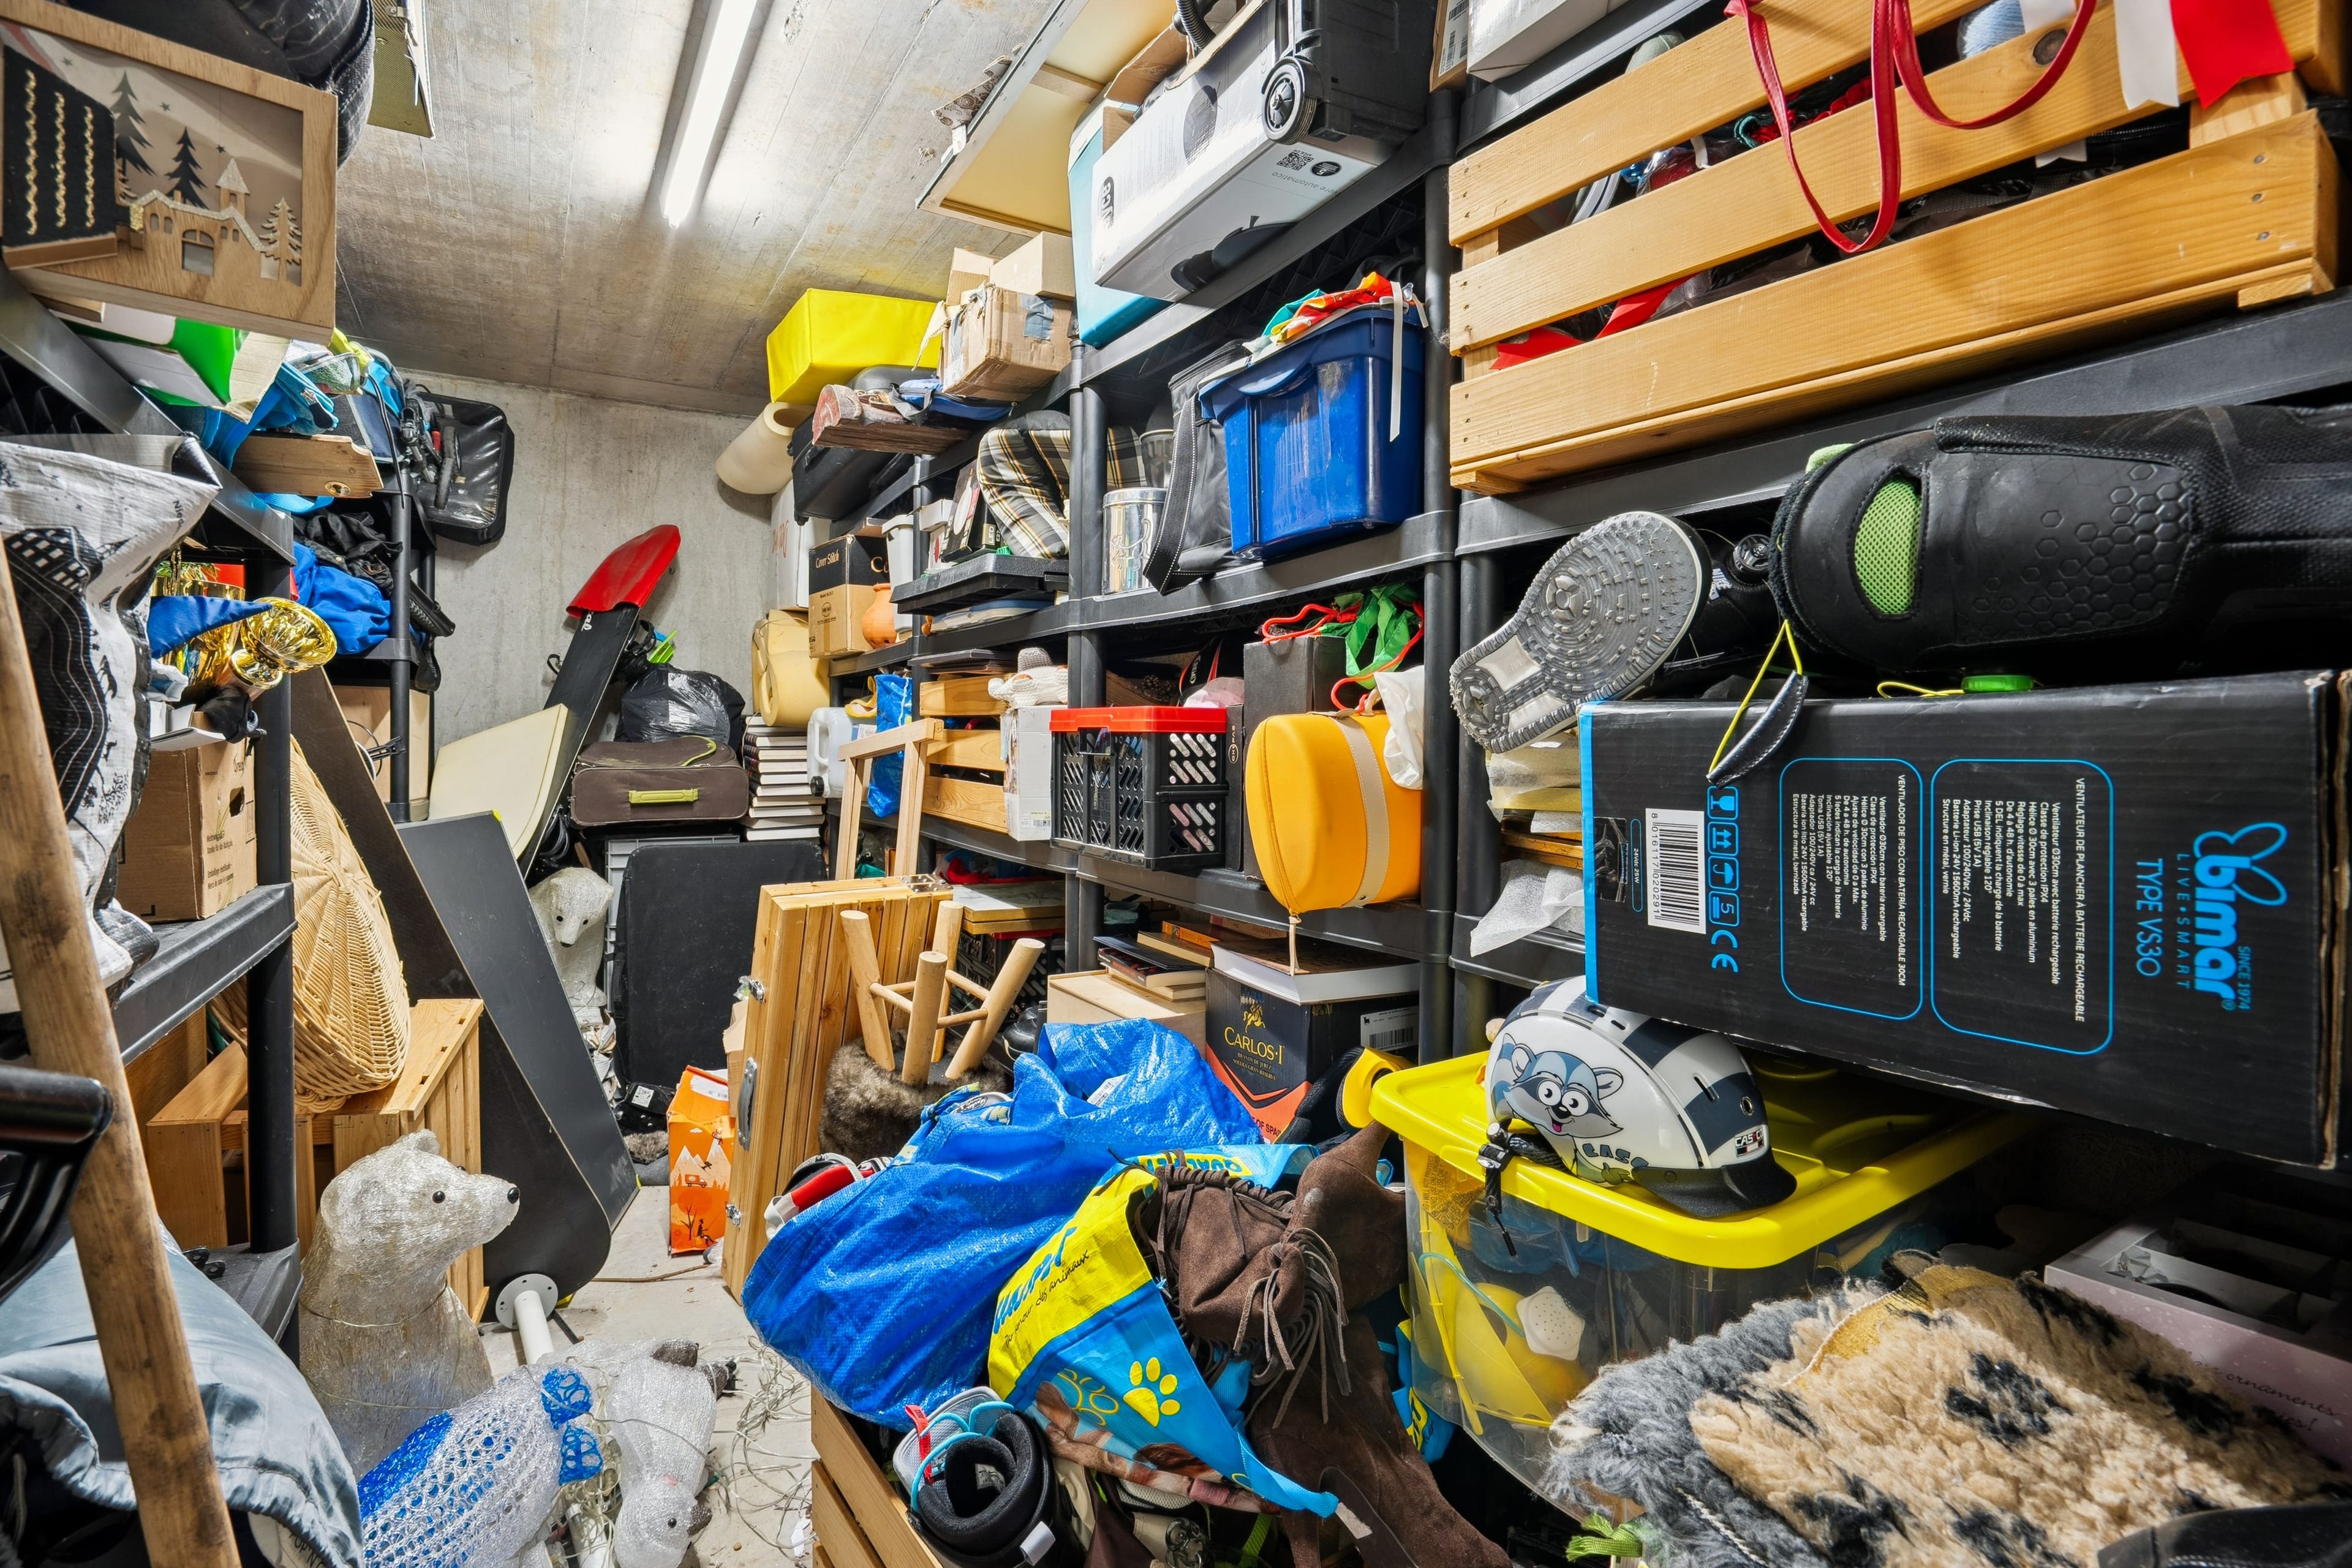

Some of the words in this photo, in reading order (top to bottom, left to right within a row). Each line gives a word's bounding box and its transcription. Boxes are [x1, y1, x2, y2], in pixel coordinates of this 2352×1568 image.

[1271, 171, 1319, 190] automatico
[815, 556, 827, 569] Cover
[827, 549, 840, 565] Stitch
[1850, 795, 1860, 818] Ajuste
[1860, 796, 1869, 818] Hélice
[1869, 796, 1878, 816] Clase
[1898, 774, 1906, 824] VENTILADOR
[2075, 778, 2086, 838] VENTILATEUR
[1852, 818, 1860, 829] de
[1869, 816, 1878, 826] de
[1879, 796, 1887, 834] Ventilador
[1942, 799, 1951, 834] Structure
[1952, 799, 1961, 829] Batterie
[1984, 800, 1993, 841] Inclinaison
[1994, 807, 2004, 824] DEL
[2015, 801, 2027, 834] Réglage
[2028, 801, 2038, 826] Hélice
[2040, 802, 2049, 828] Classe
[2051, 802, 2061, 846] Ventilateur
[1792, 829, 1800, 839] de
[1860, 827, 1869, 847] 30cm
[1898, 826, 1905, 837] DE
[1942, 835, 1950, 845] en
[1952, 831, 1961, 852] Li-ion
[1993, 825, 2004, 862] indiquent
[2040, 829, 2049, 840] de
[1824, 832, 1833, 864] ajustable
[1868, 827, 1878, 866] protección
[1941, 846, 1951, 869] métal,
[1982, 842, 1993, 873] réglable
[2016, 835, 2026, 862] vitesse
[2028, 836, 2038, 859] 30cm
[2076, 839, 2086, 851] DE
[1852, 864, 1860, 874] de
[1952, 853, 1961, 870] 24V
[2016, 863, 2026, 874] de
[2038, 841, 2049, 883] protection
[1834, 876, 1842, 886] de
[1859, 869, 1869, 888] palas
[1879, 877, 1887, 902] batería
[1942, 870, 1951, 894] vernie
[1993, 872, 2004, 899] charge
[2075, 853, 2086, 900] PLANCHER
[2136, 858, 2164, 913] TYPE
[1852, 887, 1860, 905] Máx.
[1861, 889, 1869, 899] de
[1898, 877, 1907, 910] BATERÍA
[1952, 872, 1961, 908] 15600mA
[2026, 887, 2038, 909] pales
[2040, 884, 2049, 903] IPX4
[1721, 902, 1735, 915] 5
[1800, 895, 1809, 932] recargable
[1994, 900, 2004, 911] de
[2028, 910, 2036, 920] en
[2051, 899, 2061, 931] batterie
[1877, 903, 1887, 941] recargable
[1950, 909, 1961, 959] rechargeable
[2075, 910, 2085, 951] BATTERIE
[1898, 911, 1906, 962] RECARGABLE
[1994, 921, 2004, 951] batterie
[2028, 921, 2038, 963] aluminium
[2136, 918, 2164, 978] VS30
[2049, 932, 2061, 984] rechargeable
[2237, 945, 2252, 980] SINCE
[2075, 952, 2085, 1022] RECHARGEABLE
[2237, 982, 2252, 1010] 1974
[1256, 1118, 1265, 1130] OF
[1049, 1249, 1090, 1294] animaux
[2226, 1373, 2341, 1417] ornaments
